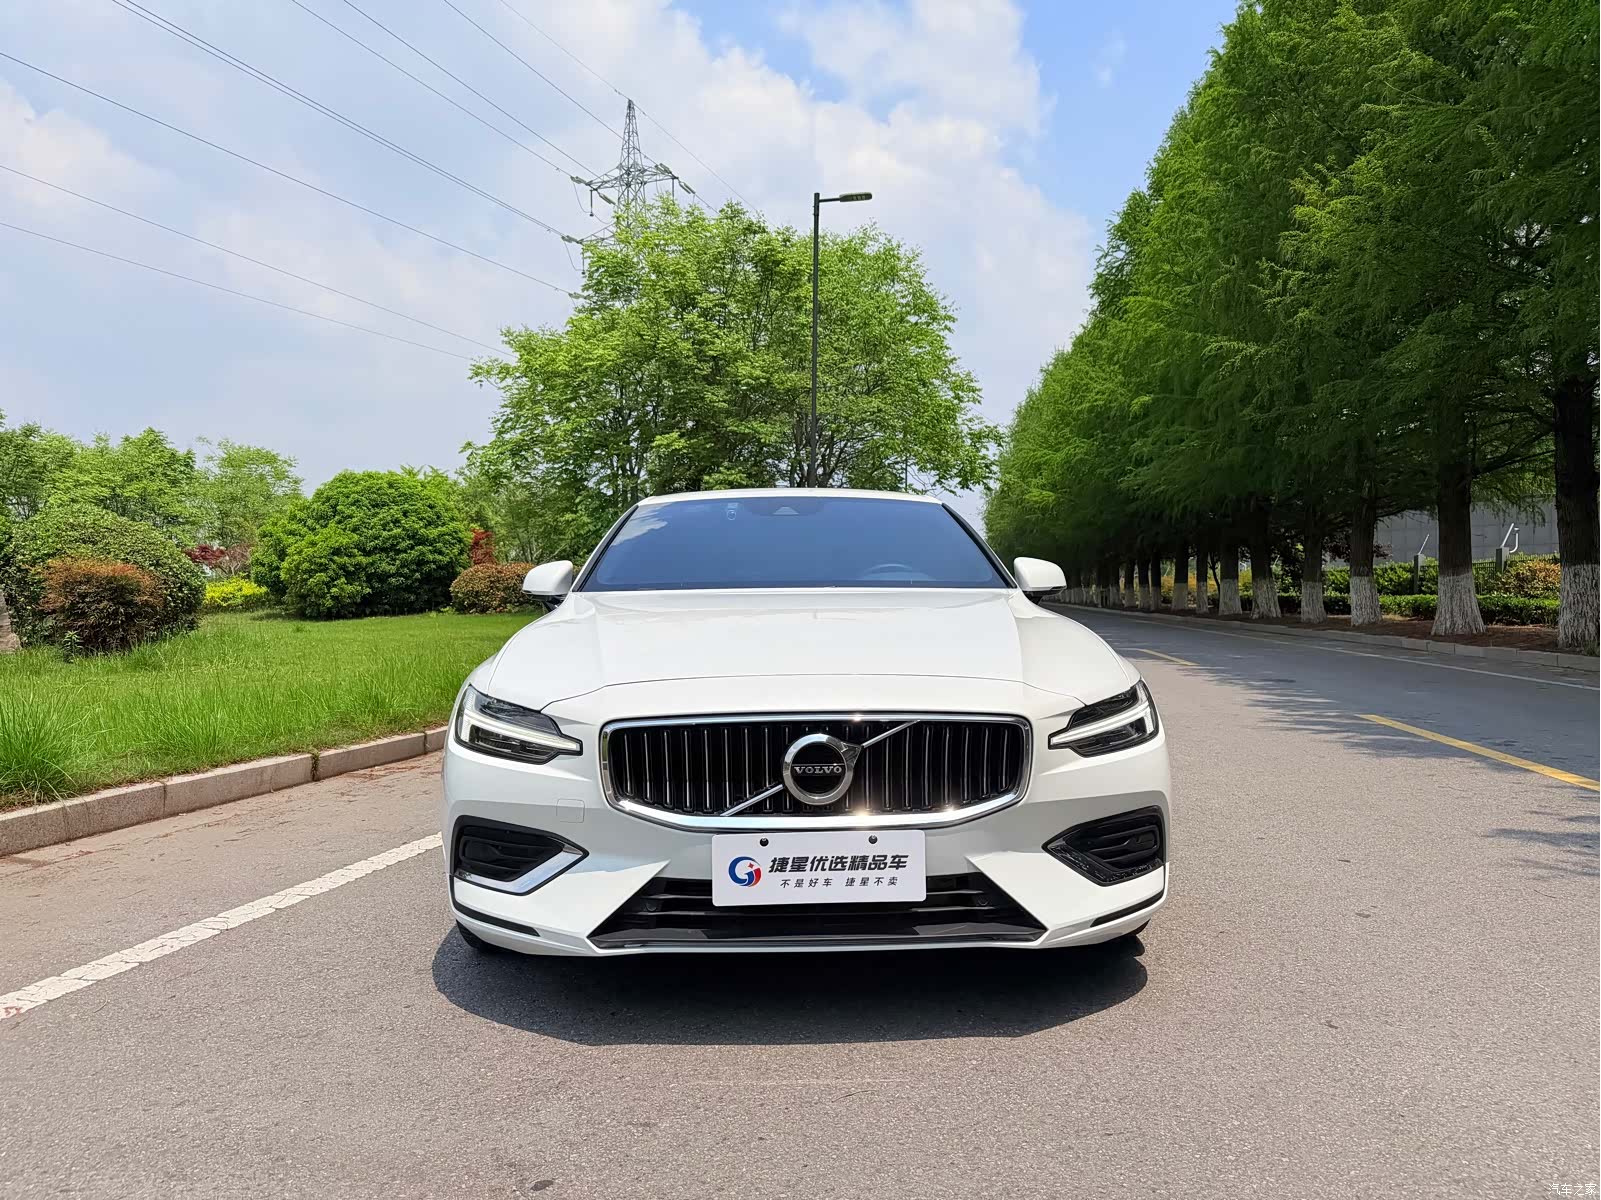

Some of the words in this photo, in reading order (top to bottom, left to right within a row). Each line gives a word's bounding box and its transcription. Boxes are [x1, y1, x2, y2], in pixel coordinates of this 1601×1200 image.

[793, 766, 842, 774] VOLVO
[768, 854, 909, 873] 捷星优选精品车
[780, 878, 833, 888] 不是好车
[845, 876, 898, 887] 捷星不卖
